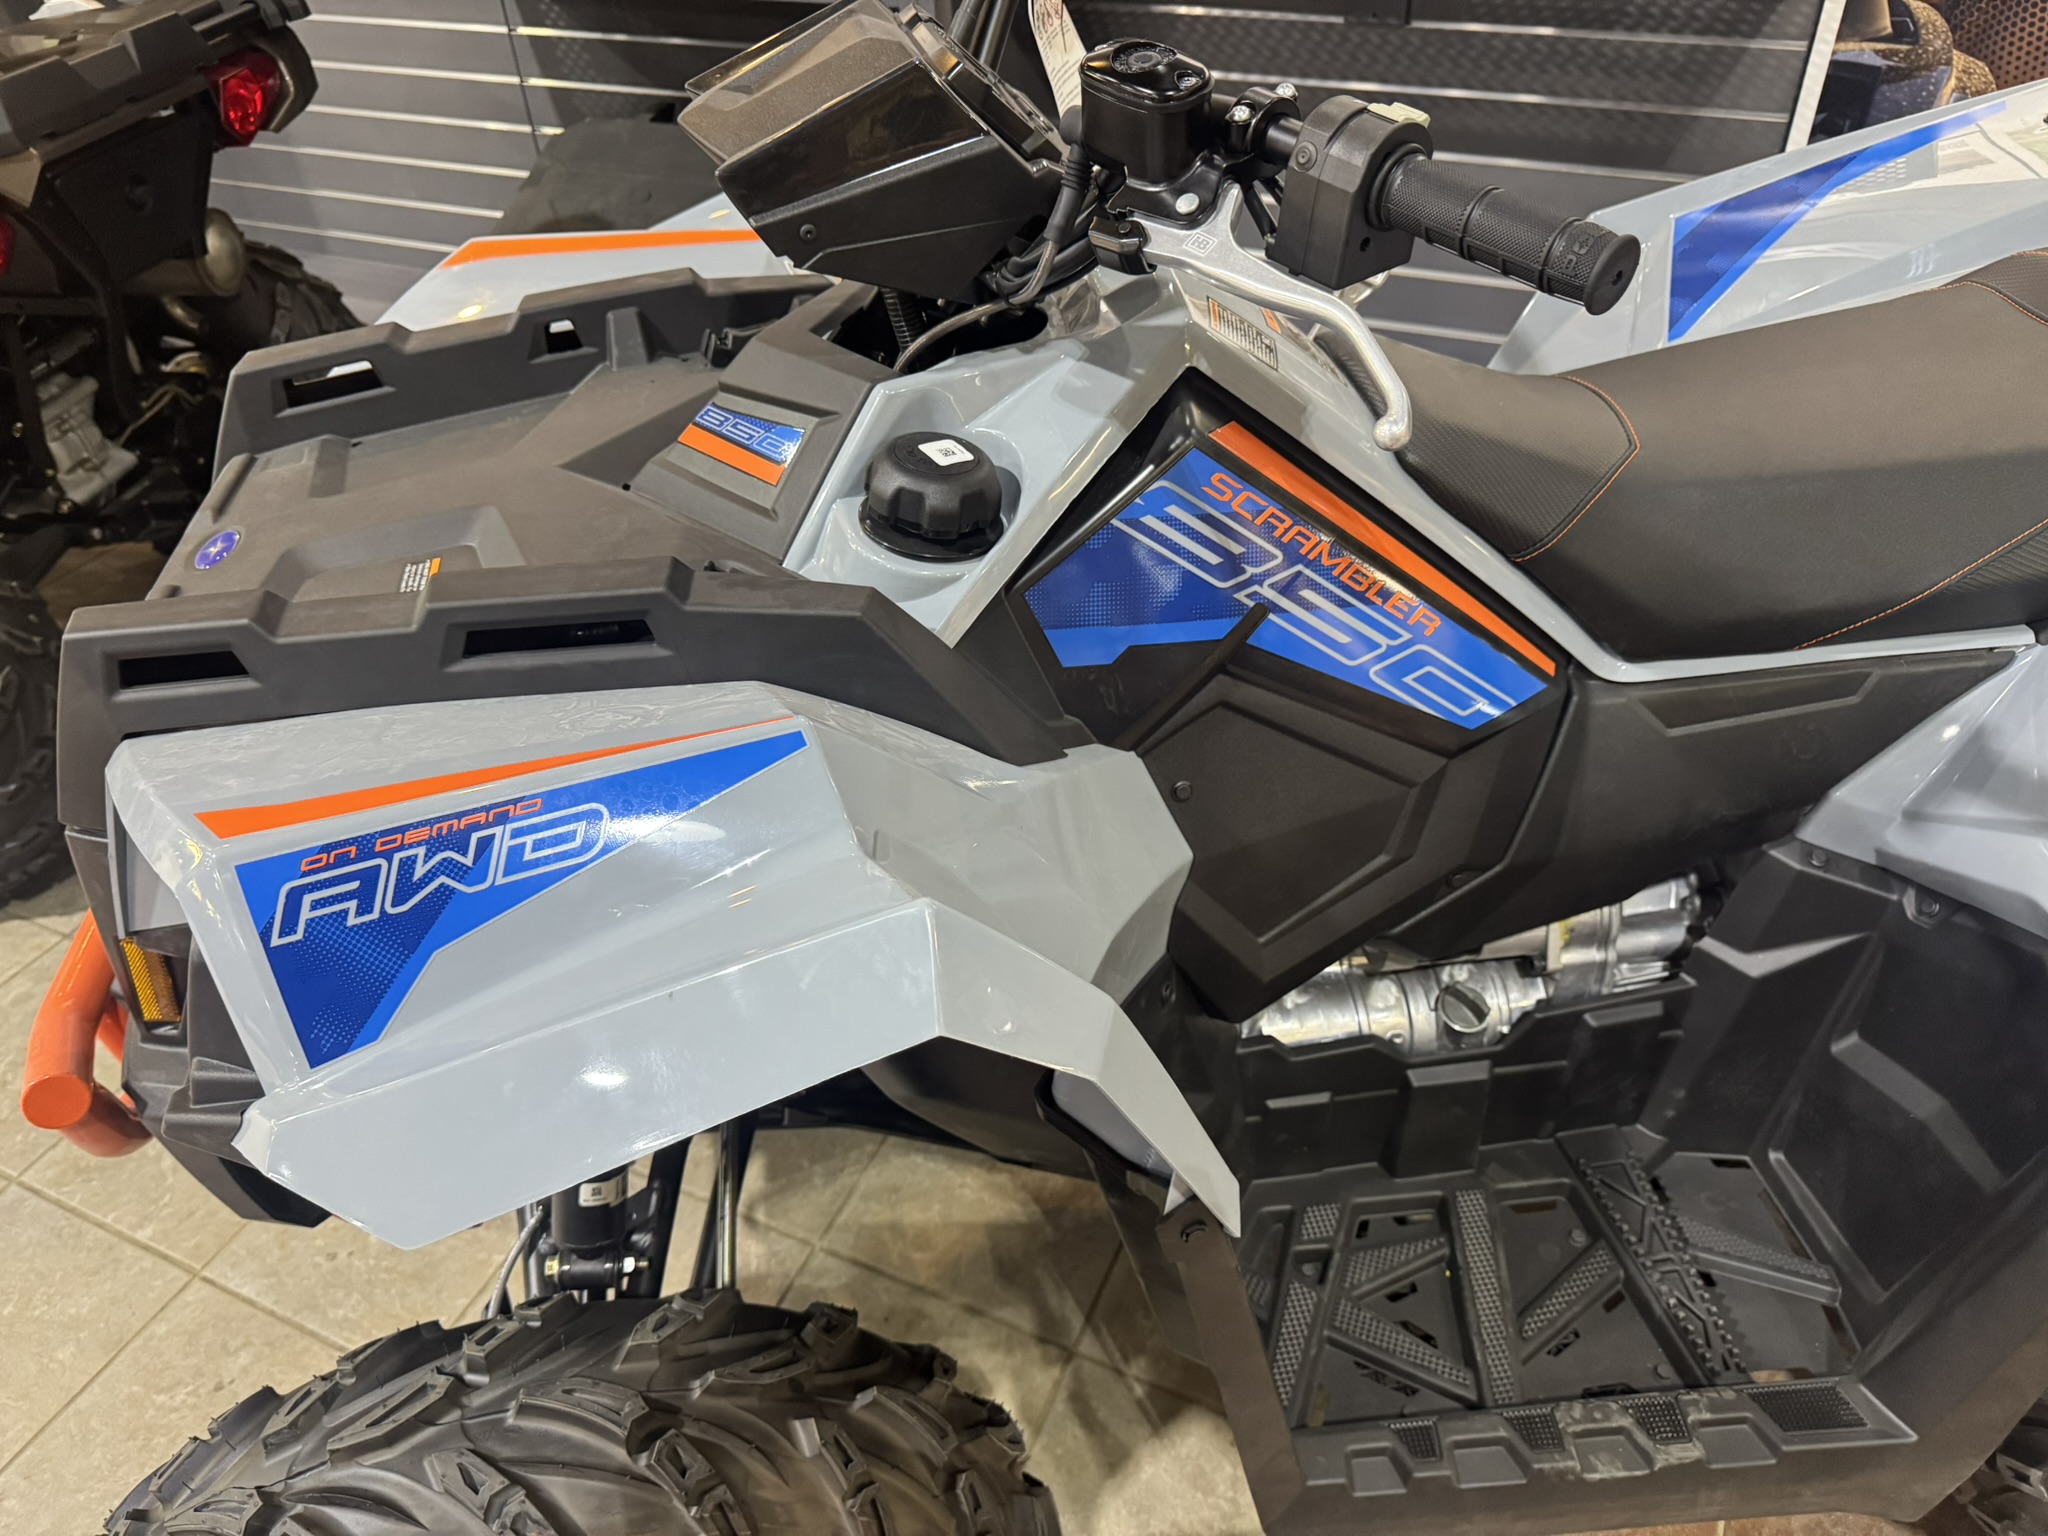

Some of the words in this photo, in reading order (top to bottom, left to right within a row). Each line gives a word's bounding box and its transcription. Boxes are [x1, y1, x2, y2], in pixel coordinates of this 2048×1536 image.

[695, 405, 791, 462] 850
[1110, 480, 1517, 720] 850
[1201, 472, 1442, 636] SCRAMBLER
[270, 802, 611, 947] AWD
[300, 846, 356, 872] ON
[374, 798, 543, 852] DEMAND
